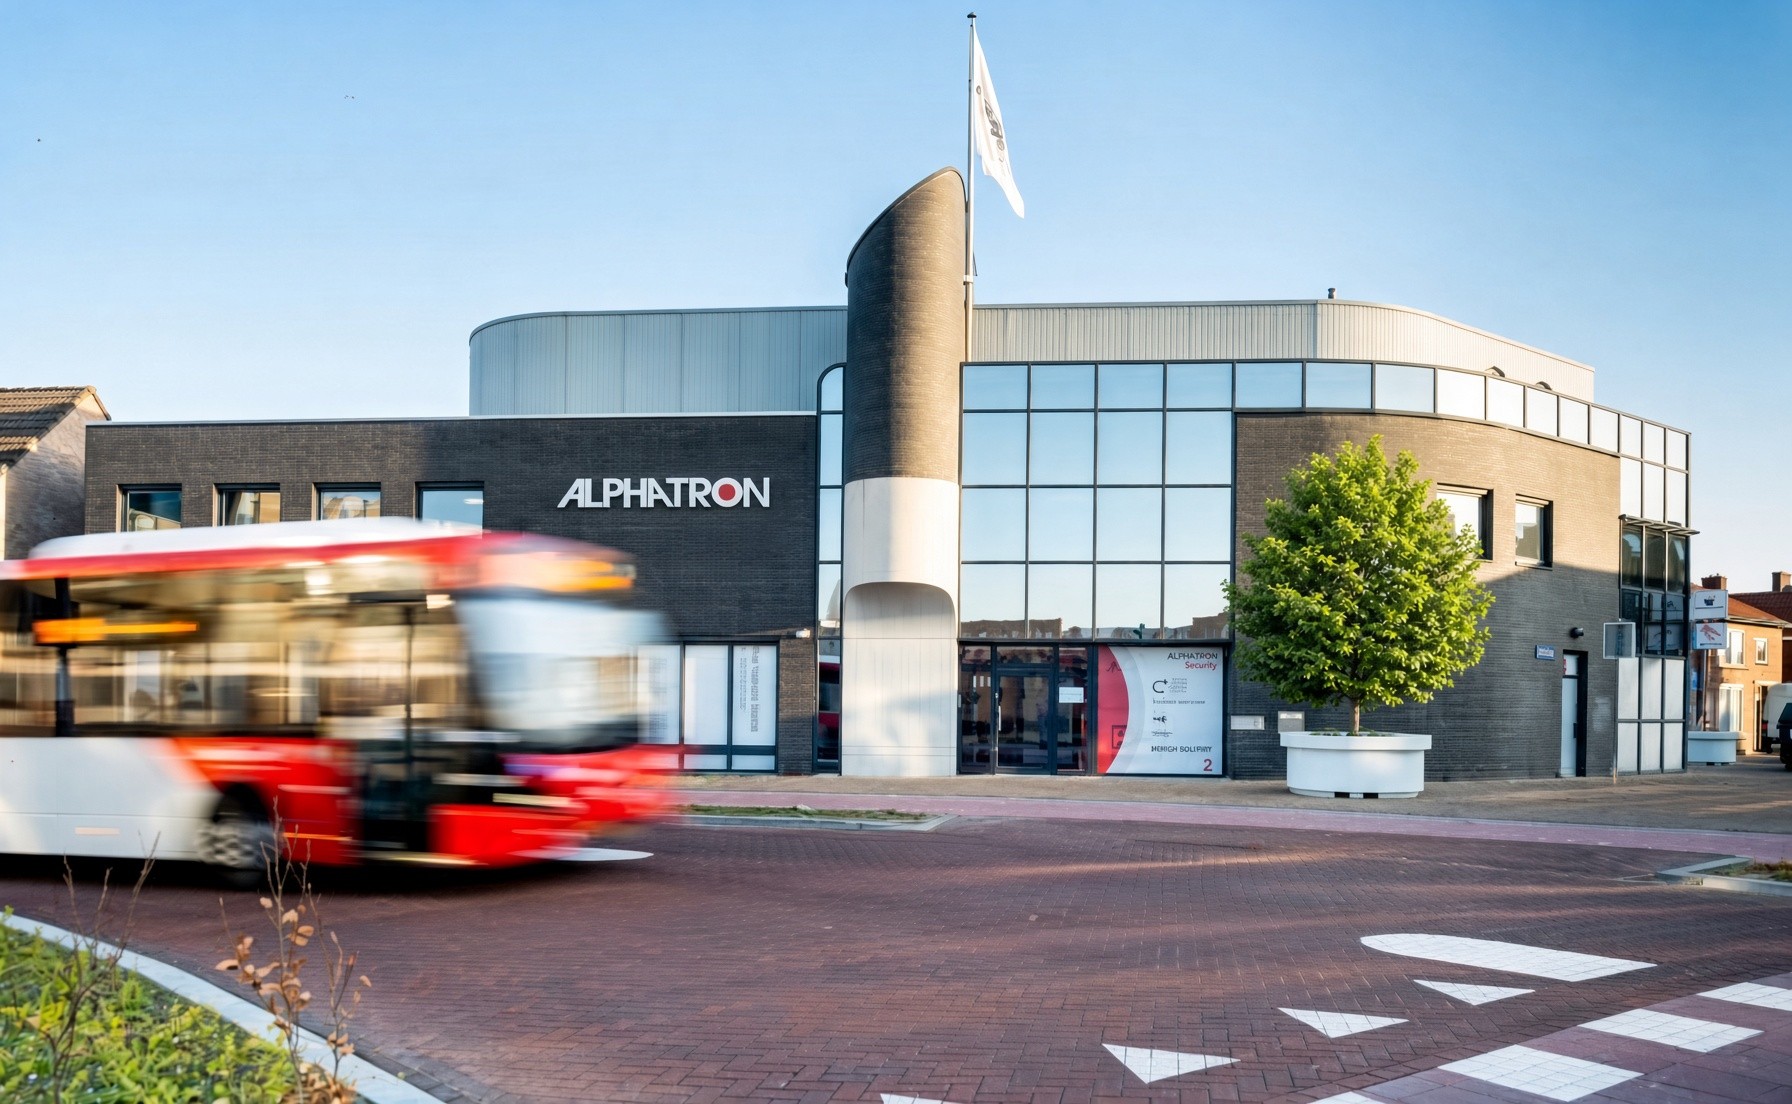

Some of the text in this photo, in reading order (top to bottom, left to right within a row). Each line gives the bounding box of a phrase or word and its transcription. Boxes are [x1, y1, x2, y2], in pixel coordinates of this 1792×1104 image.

[557, 477, 770, 508] ALPHATRON
[1167, 652, 1218, 660] ALPHATRON
[1184, 661, 1217, 671] Security
[1203, 758, 1213, 772] 2
